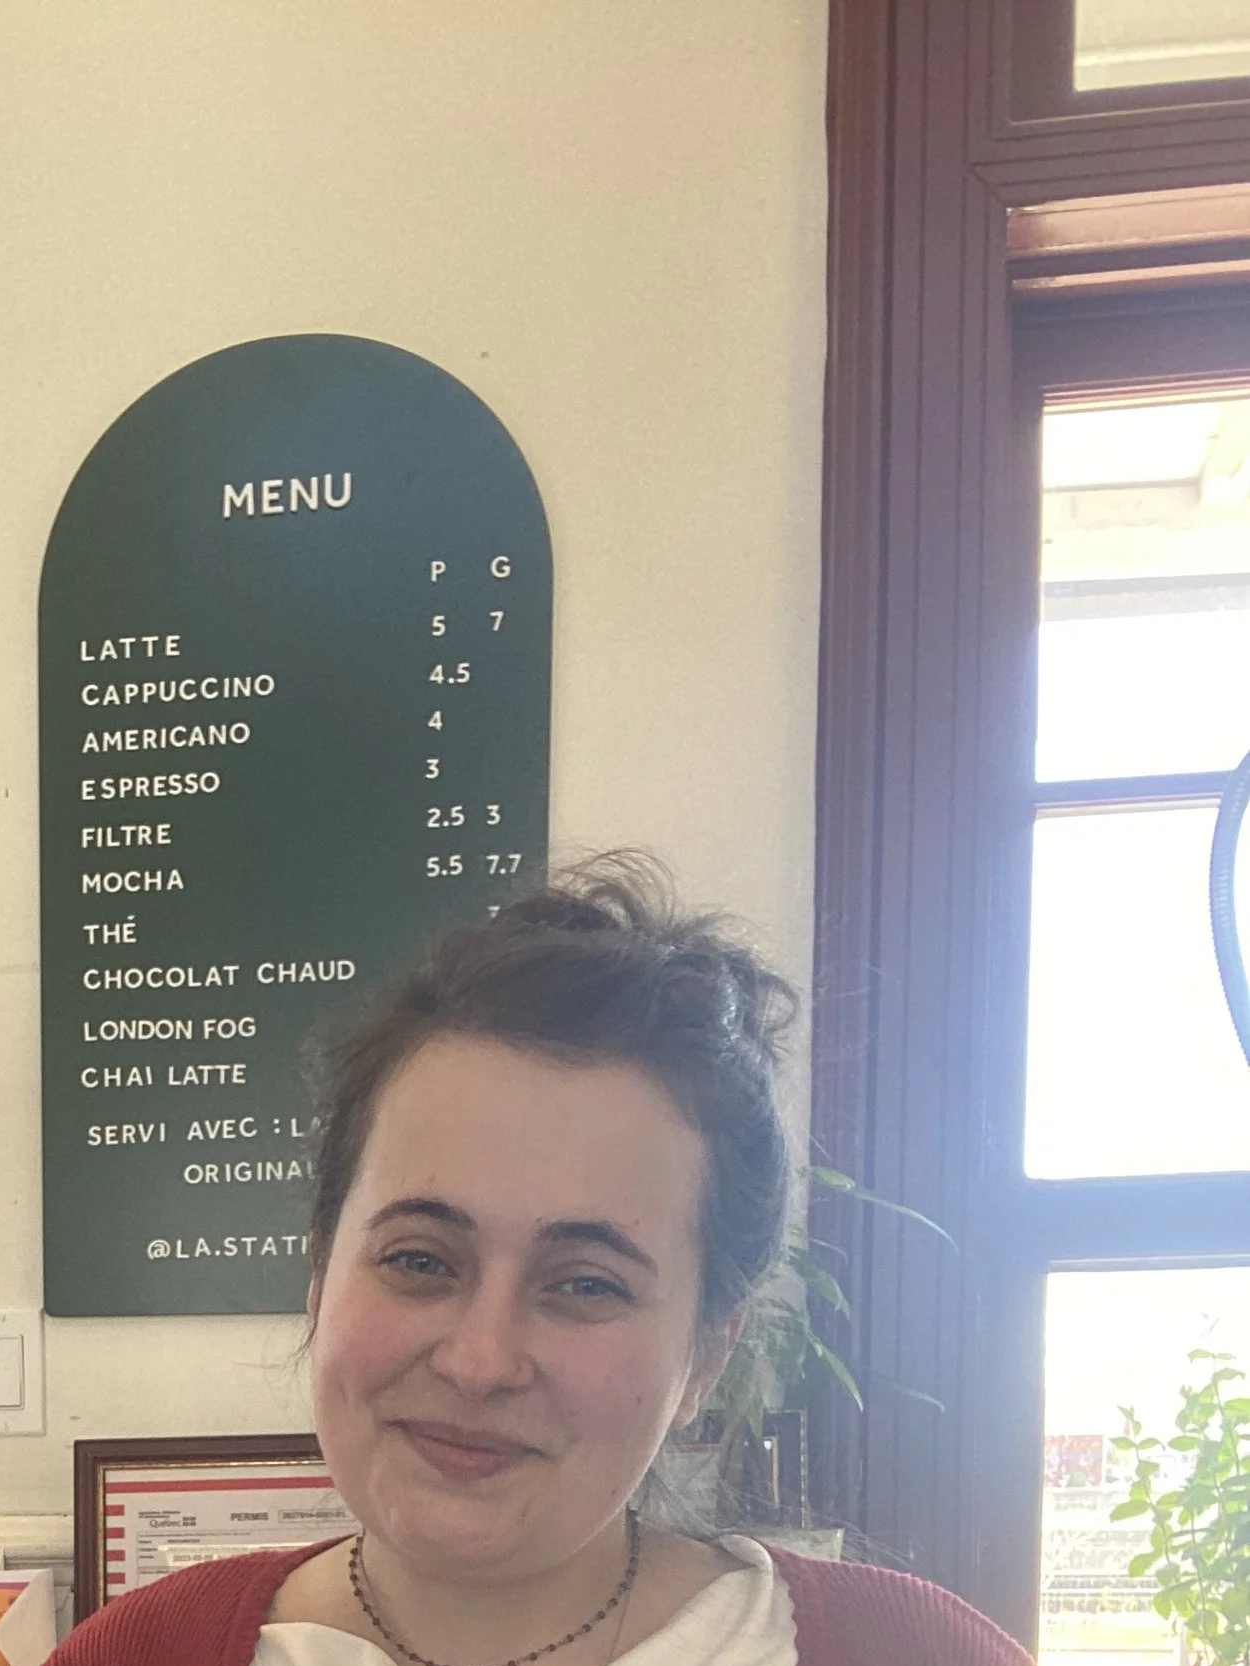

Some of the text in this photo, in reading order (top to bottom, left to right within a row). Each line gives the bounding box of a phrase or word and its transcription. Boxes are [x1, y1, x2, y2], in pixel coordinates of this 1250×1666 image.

[223, 472, 352, 518] MENU
[431, 555, 511, 582] P G
[80, 610, 504, 662] LATTE 5 7
[81, 662, 471, 706] CAPPUCCINO 4.5
[82, 710, 443, 754] AMERICANO 4
[81, 758, 439, 801] ESPRESSO 3
[81, 804, 501, 849] FILTRE 2.5 3
[82, 853, 522, 894] MOCHA 5.5 7.7
[82, 915, 137, 945] THÉ
[83, 960, 356, 990] CHOCOLAT CHAUD
[83, 1016, 256, 1042] LONDON FOG
[80, 1063, 247, 1088] CHAI LATTE
[87, 1122, 166, 1146] SERVI
[187, 1116, 258, 1141] AVEC
[231, 1512, 269, 1521] PERMIS
